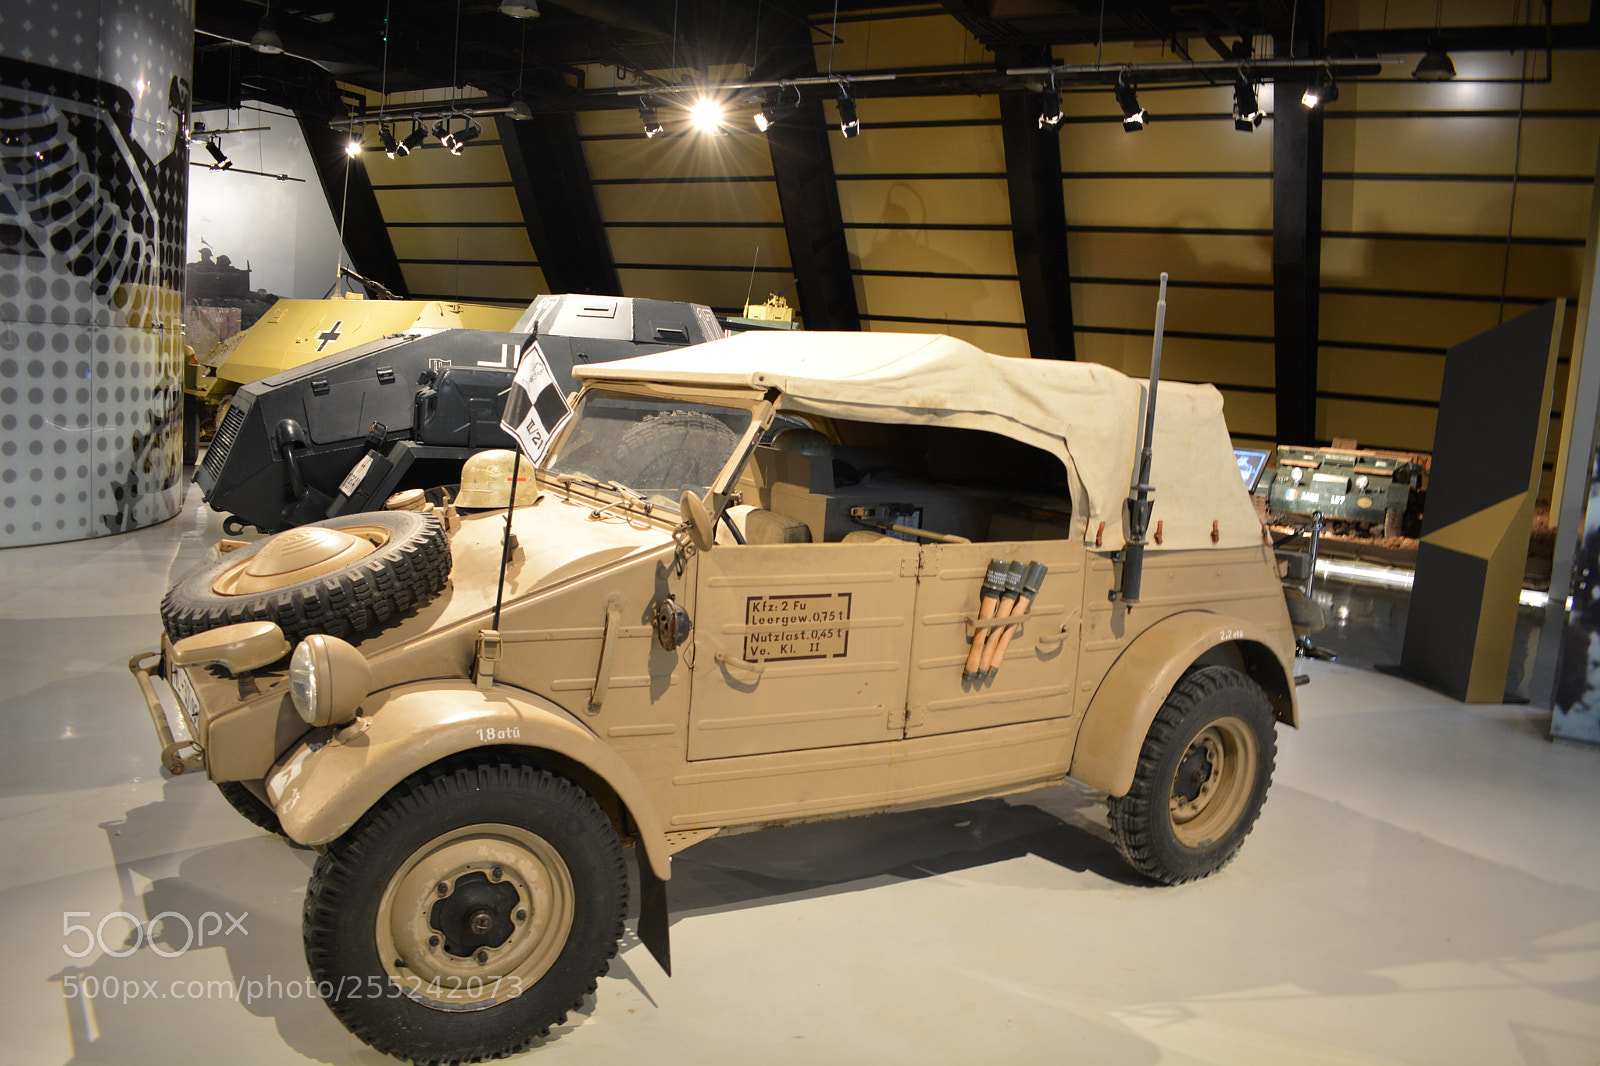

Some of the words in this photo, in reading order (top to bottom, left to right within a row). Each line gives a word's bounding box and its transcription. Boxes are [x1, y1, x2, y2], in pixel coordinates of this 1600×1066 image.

[781, 601, 788, 611] 2
[793, 601, 806, 610] Fu
[839, 611, 843, 620] t
[837, 629, 842, 638] t
[809, 642, 820, 652] II
